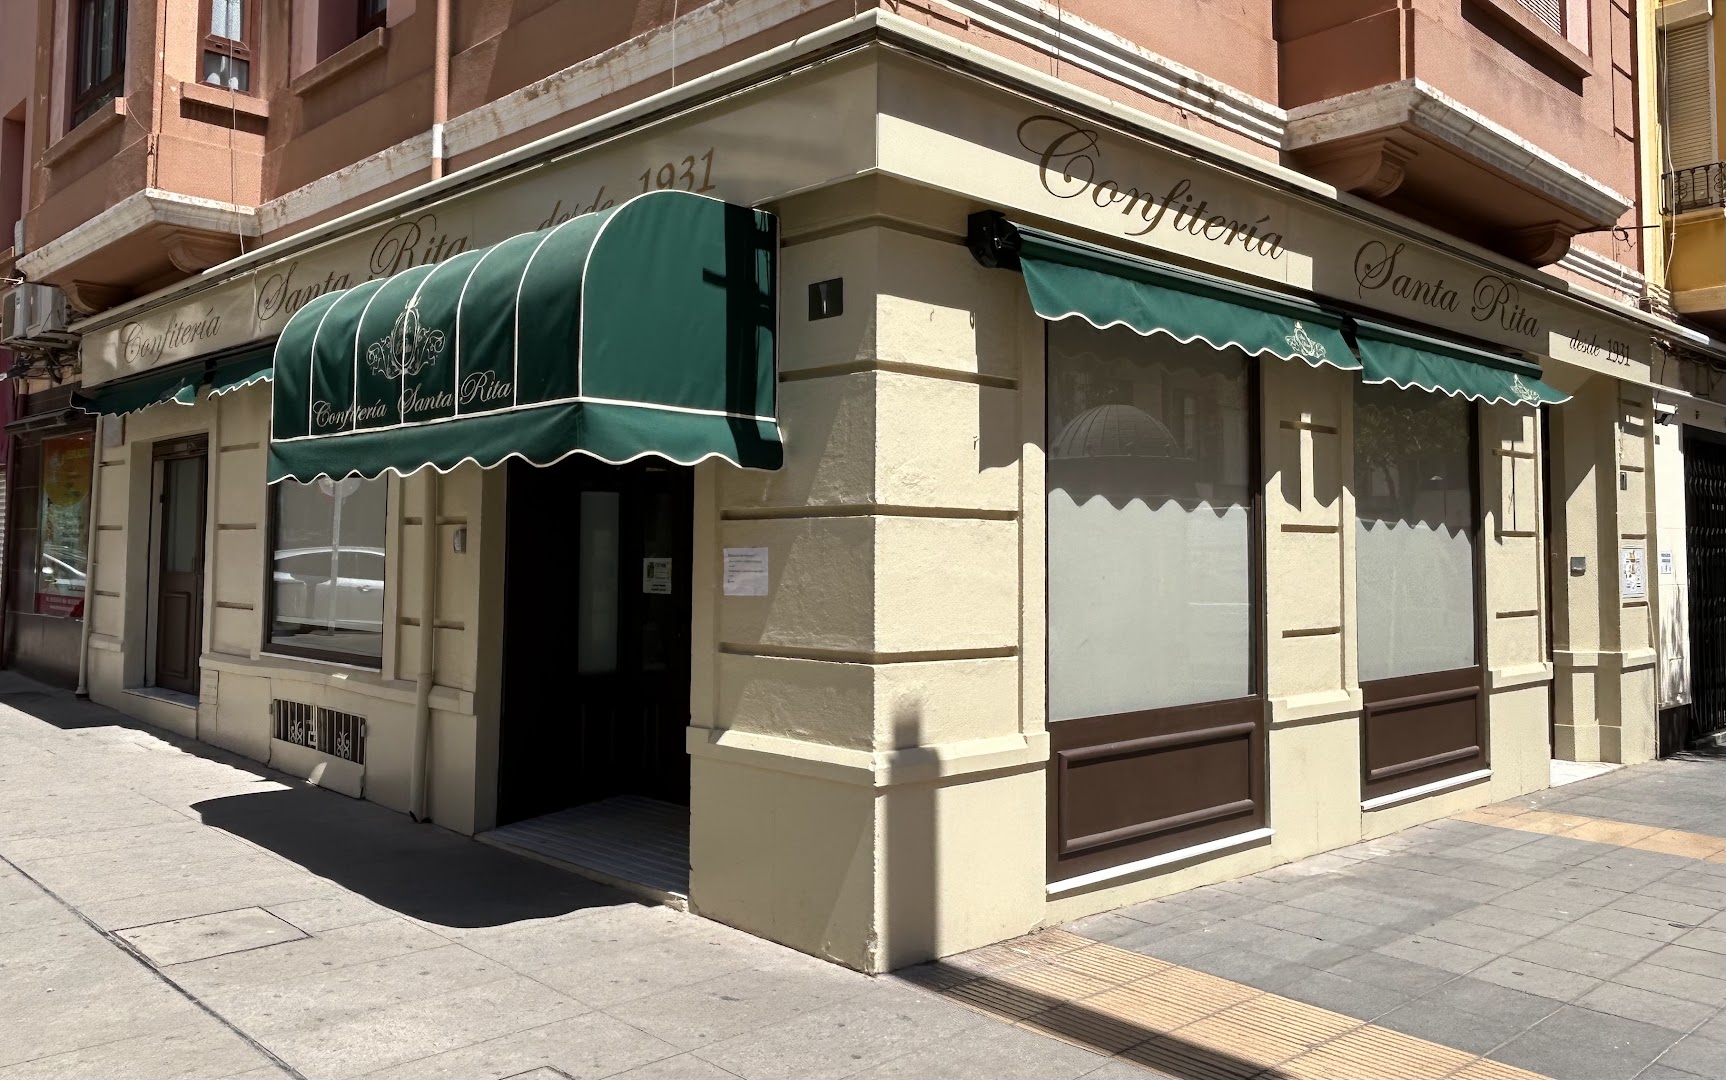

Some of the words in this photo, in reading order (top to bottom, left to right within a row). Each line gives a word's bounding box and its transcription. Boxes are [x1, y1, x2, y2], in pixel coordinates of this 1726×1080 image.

[120, 305, 223, 365] Confitería
[256, 261, 352, 332] Santa
[367, 213, 470, 280] Rita
[638, 146, 716, 193] 1931
[1017, 115, 1285, 260] Confitería
[1354, 240, 1460, 313] Santa
[1471, 275, 1540, 338] Rita
[1569, 329, 1601, 357] desde
[1606, 338, 1631, 367] 1931
[397, 382, 453, 415] Santa
[459, 369, 513, 405] Rita
